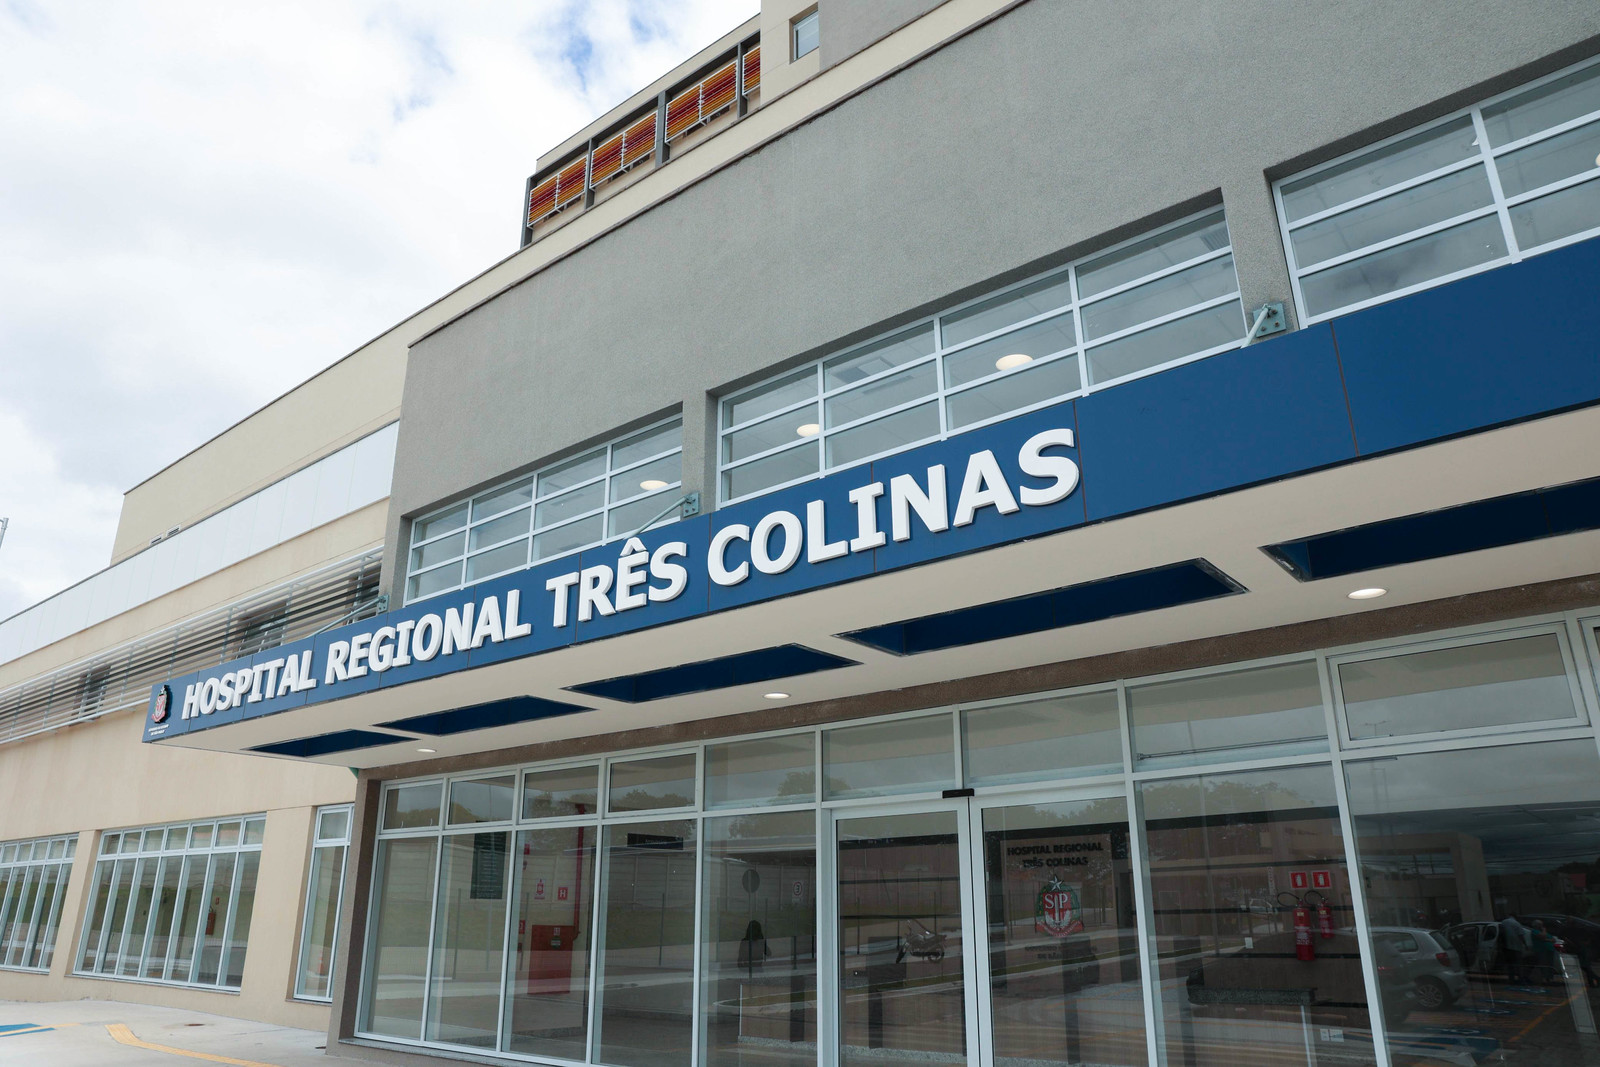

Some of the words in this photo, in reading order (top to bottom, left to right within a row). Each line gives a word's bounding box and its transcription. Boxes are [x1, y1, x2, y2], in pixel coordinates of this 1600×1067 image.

[181, 650, 317, 720] HOSPITAL
[325, 588, 532, 685] REGIONAL
[545, 537, 689, 628] TRÊS
[707, 428, 1080, 587] COLINAS
[1007, 845, 1052, 856] HOSPITAL
[1053, 842, 1104, 853] REGIONAL
[1046, 856, 1089, 867] COLINAS
